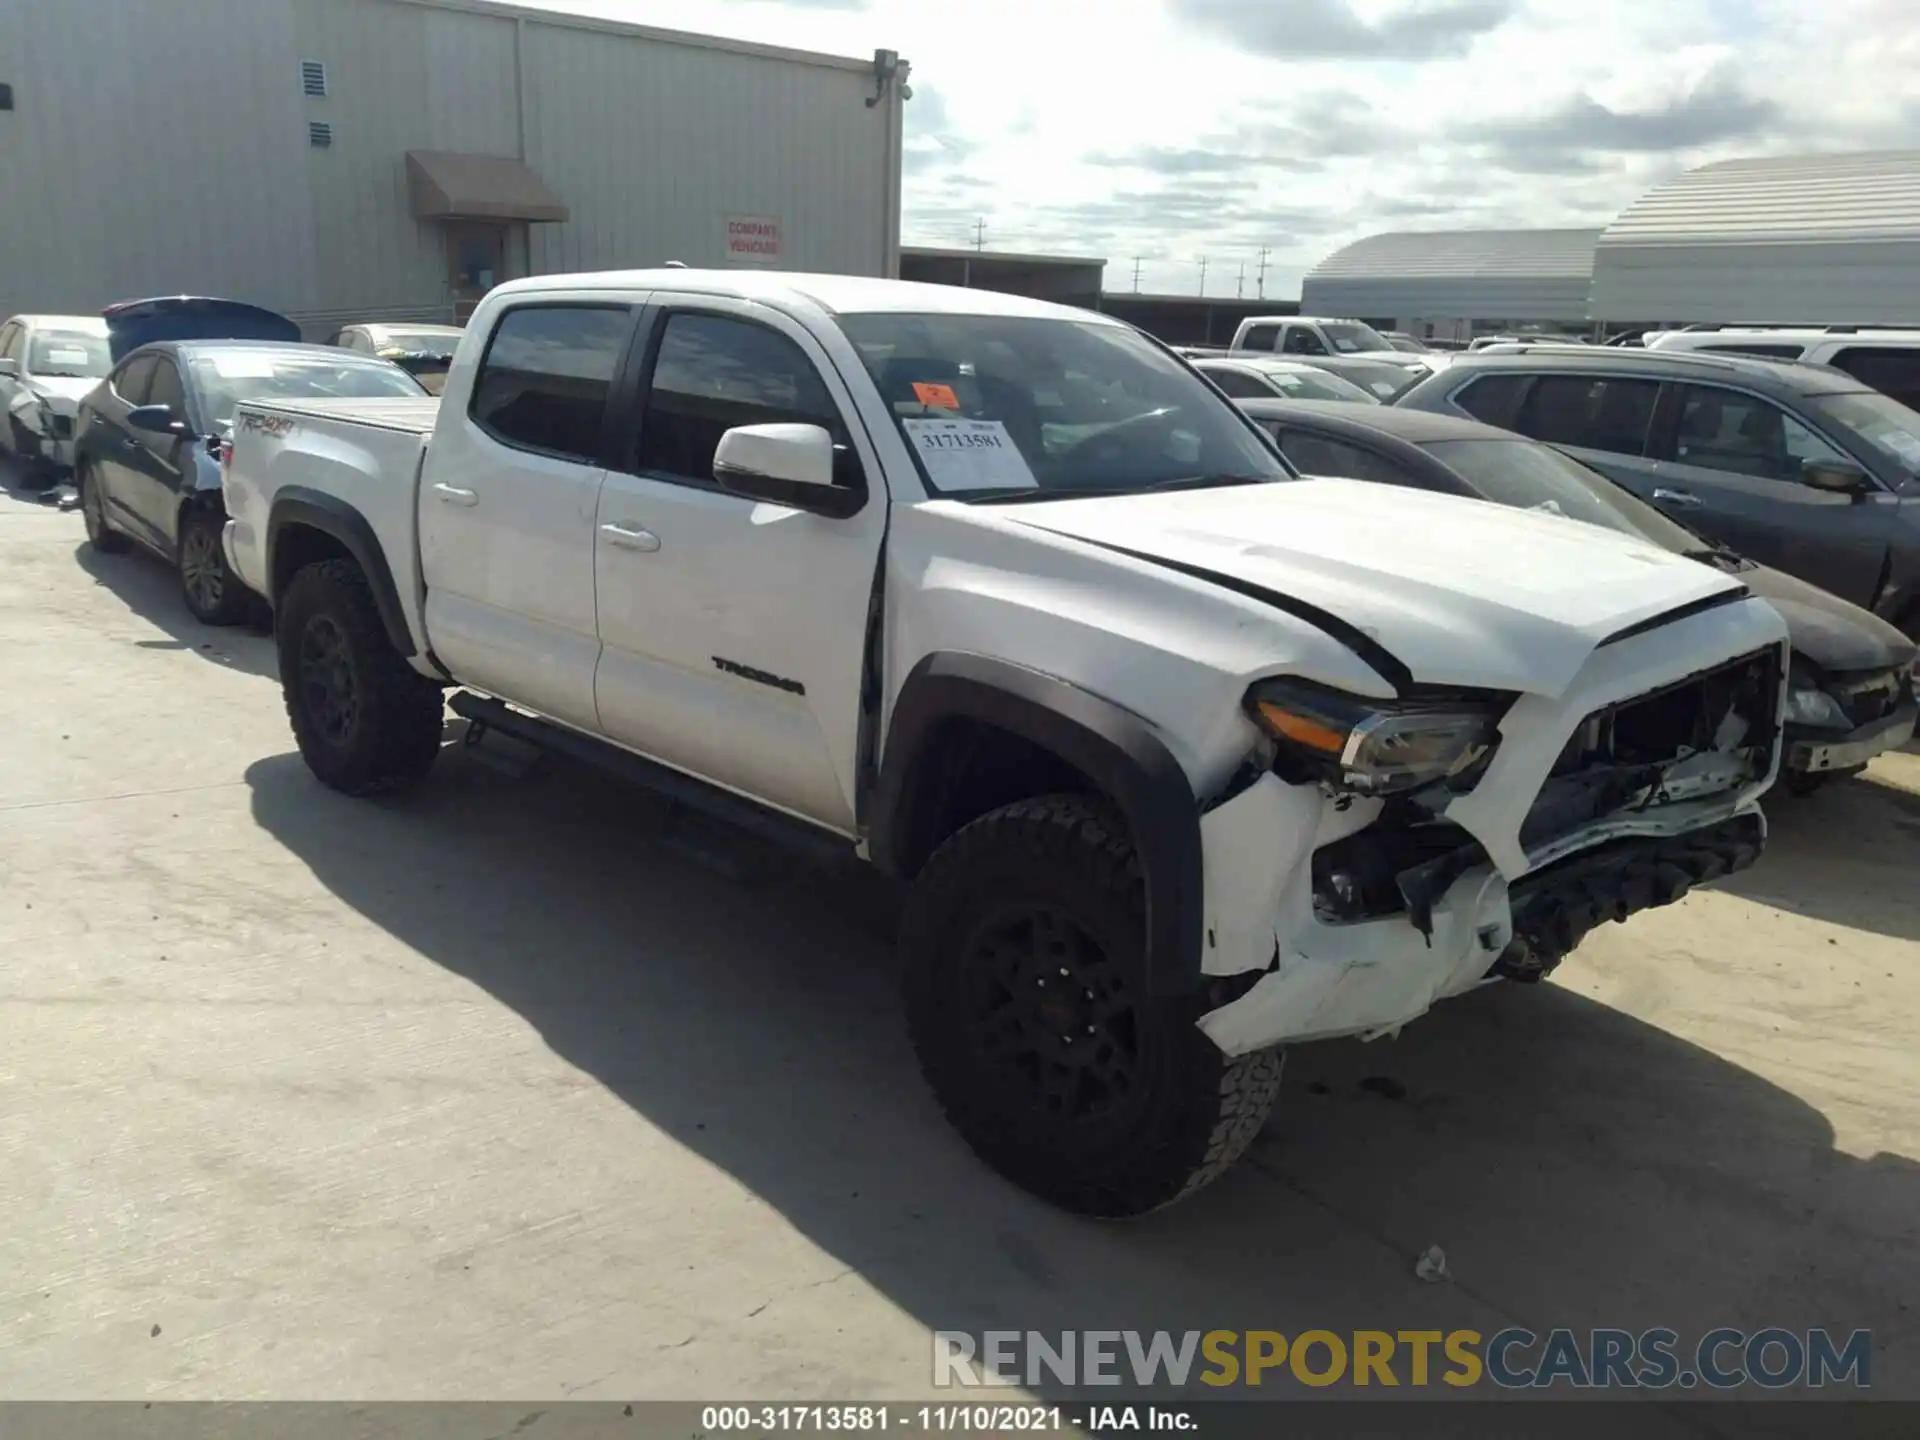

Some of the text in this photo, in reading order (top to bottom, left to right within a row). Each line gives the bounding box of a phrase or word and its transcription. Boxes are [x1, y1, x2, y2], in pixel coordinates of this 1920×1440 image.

[728, 221, 778, 238] COMPANY
[729, 239, 779, 255] VEHICLES
[922, 434, 1002, 449] 31713581
